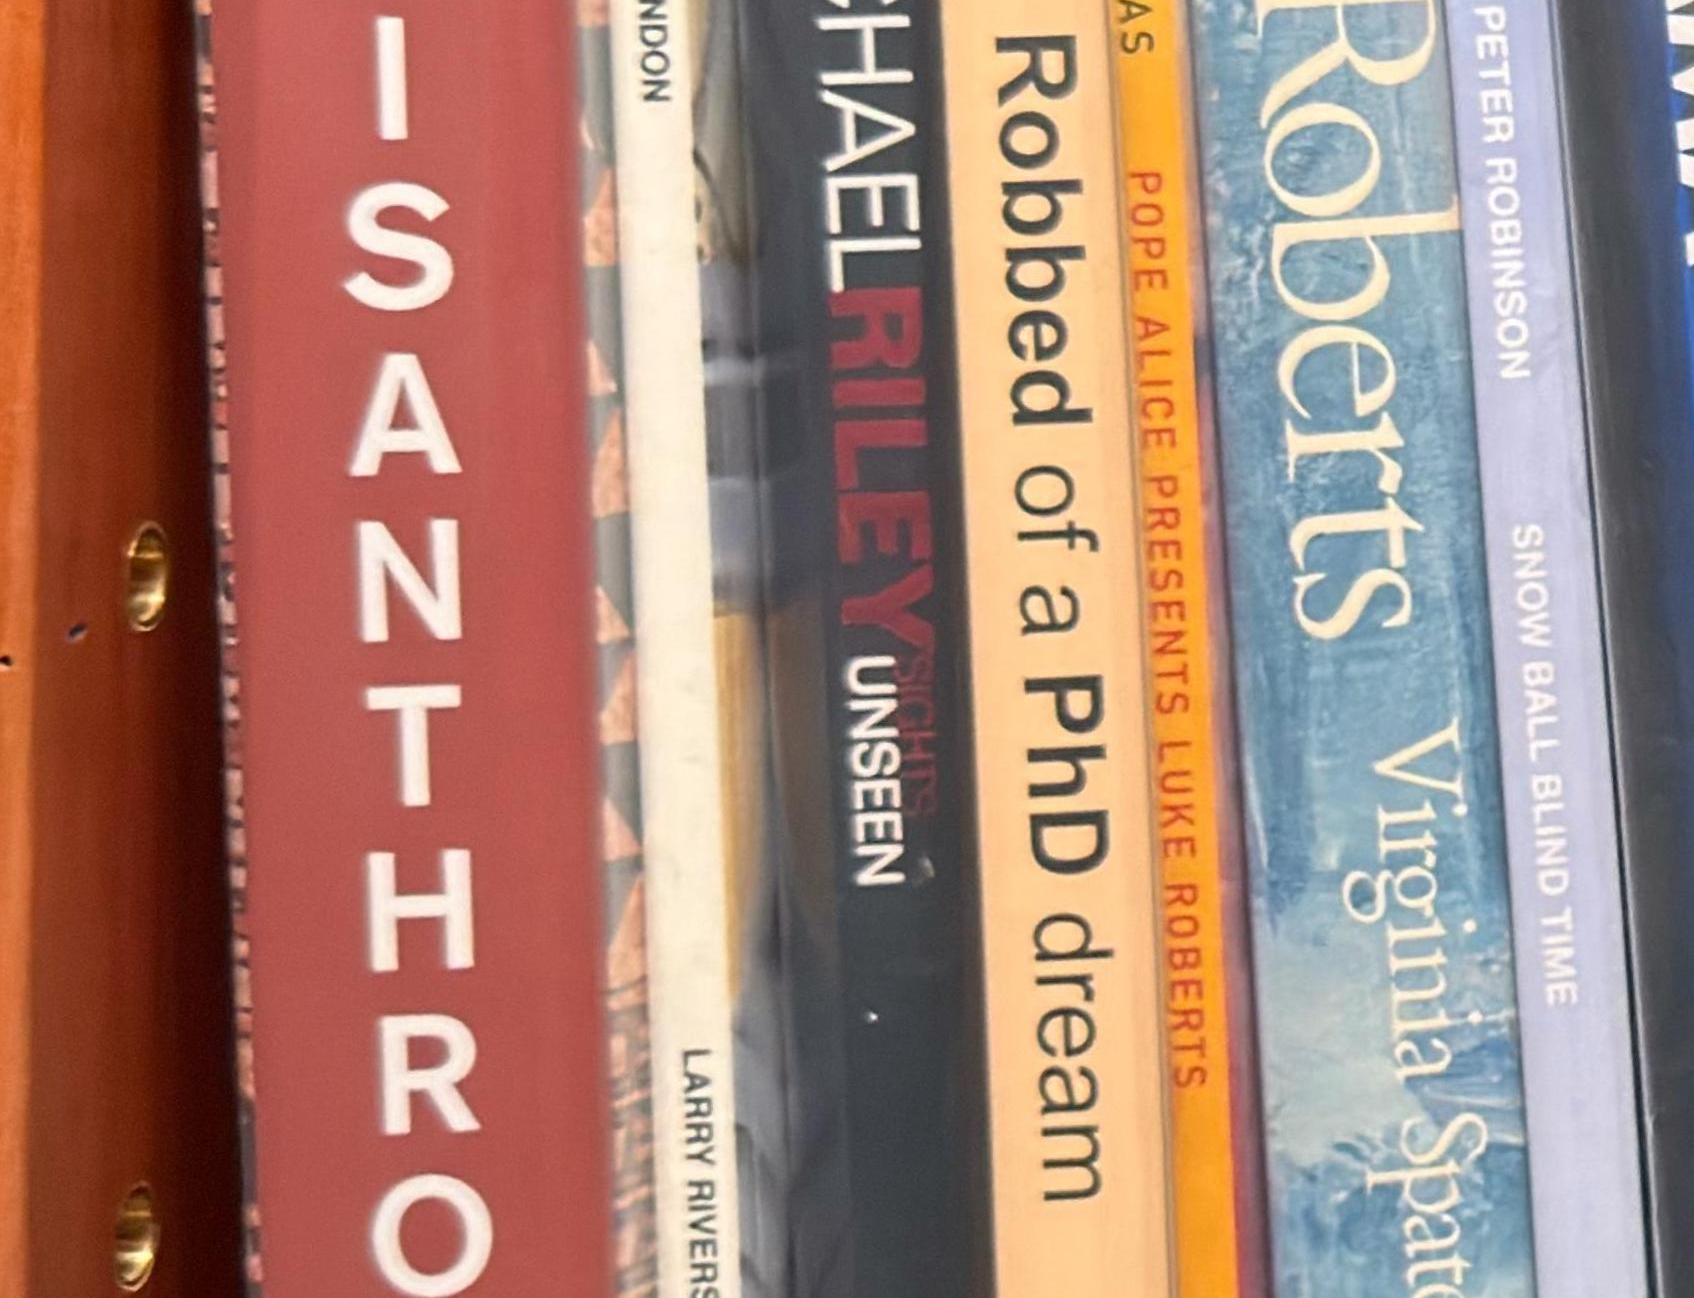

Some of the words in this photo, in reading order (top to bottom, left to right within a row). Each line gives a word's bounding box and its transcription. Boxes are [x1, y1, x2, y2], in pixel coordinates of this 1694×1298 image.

[1474, 6, 1515, 143] PETER
[994, 33, 1094, 426] Robbed
[1129, 170, 1170, 291] POPE
[1486, 157, 1531, 380] ROBINSON
[1135, 315, 1177, 450] ALICE
[829, 286, 936, 648] RILEY
[1013, 464, 1099, 552] of
[1019, 584, 1081, 636] a
[1143, 474, 1190, 716] PRESENTS
[1511, 524, 1552, 646] SNOW
[844, 654, 906, 886] UNSEEN
[1023, 673, 1111, 875] PhD
[1523, 661, 1555, 761] BALL
[1159, 739, 1196, 859] LUKE
[1530, 773, 1570, 897] BLIND
[1342, 718, 1484, 1080] Virginia
[1540, 907, 1578, 1006] TIME
[1163, 881, 1207, 1089] ROBERTS
[683, 1049, 716, 1165] LARRY
[1033, 911, 1114, 1201] dream
